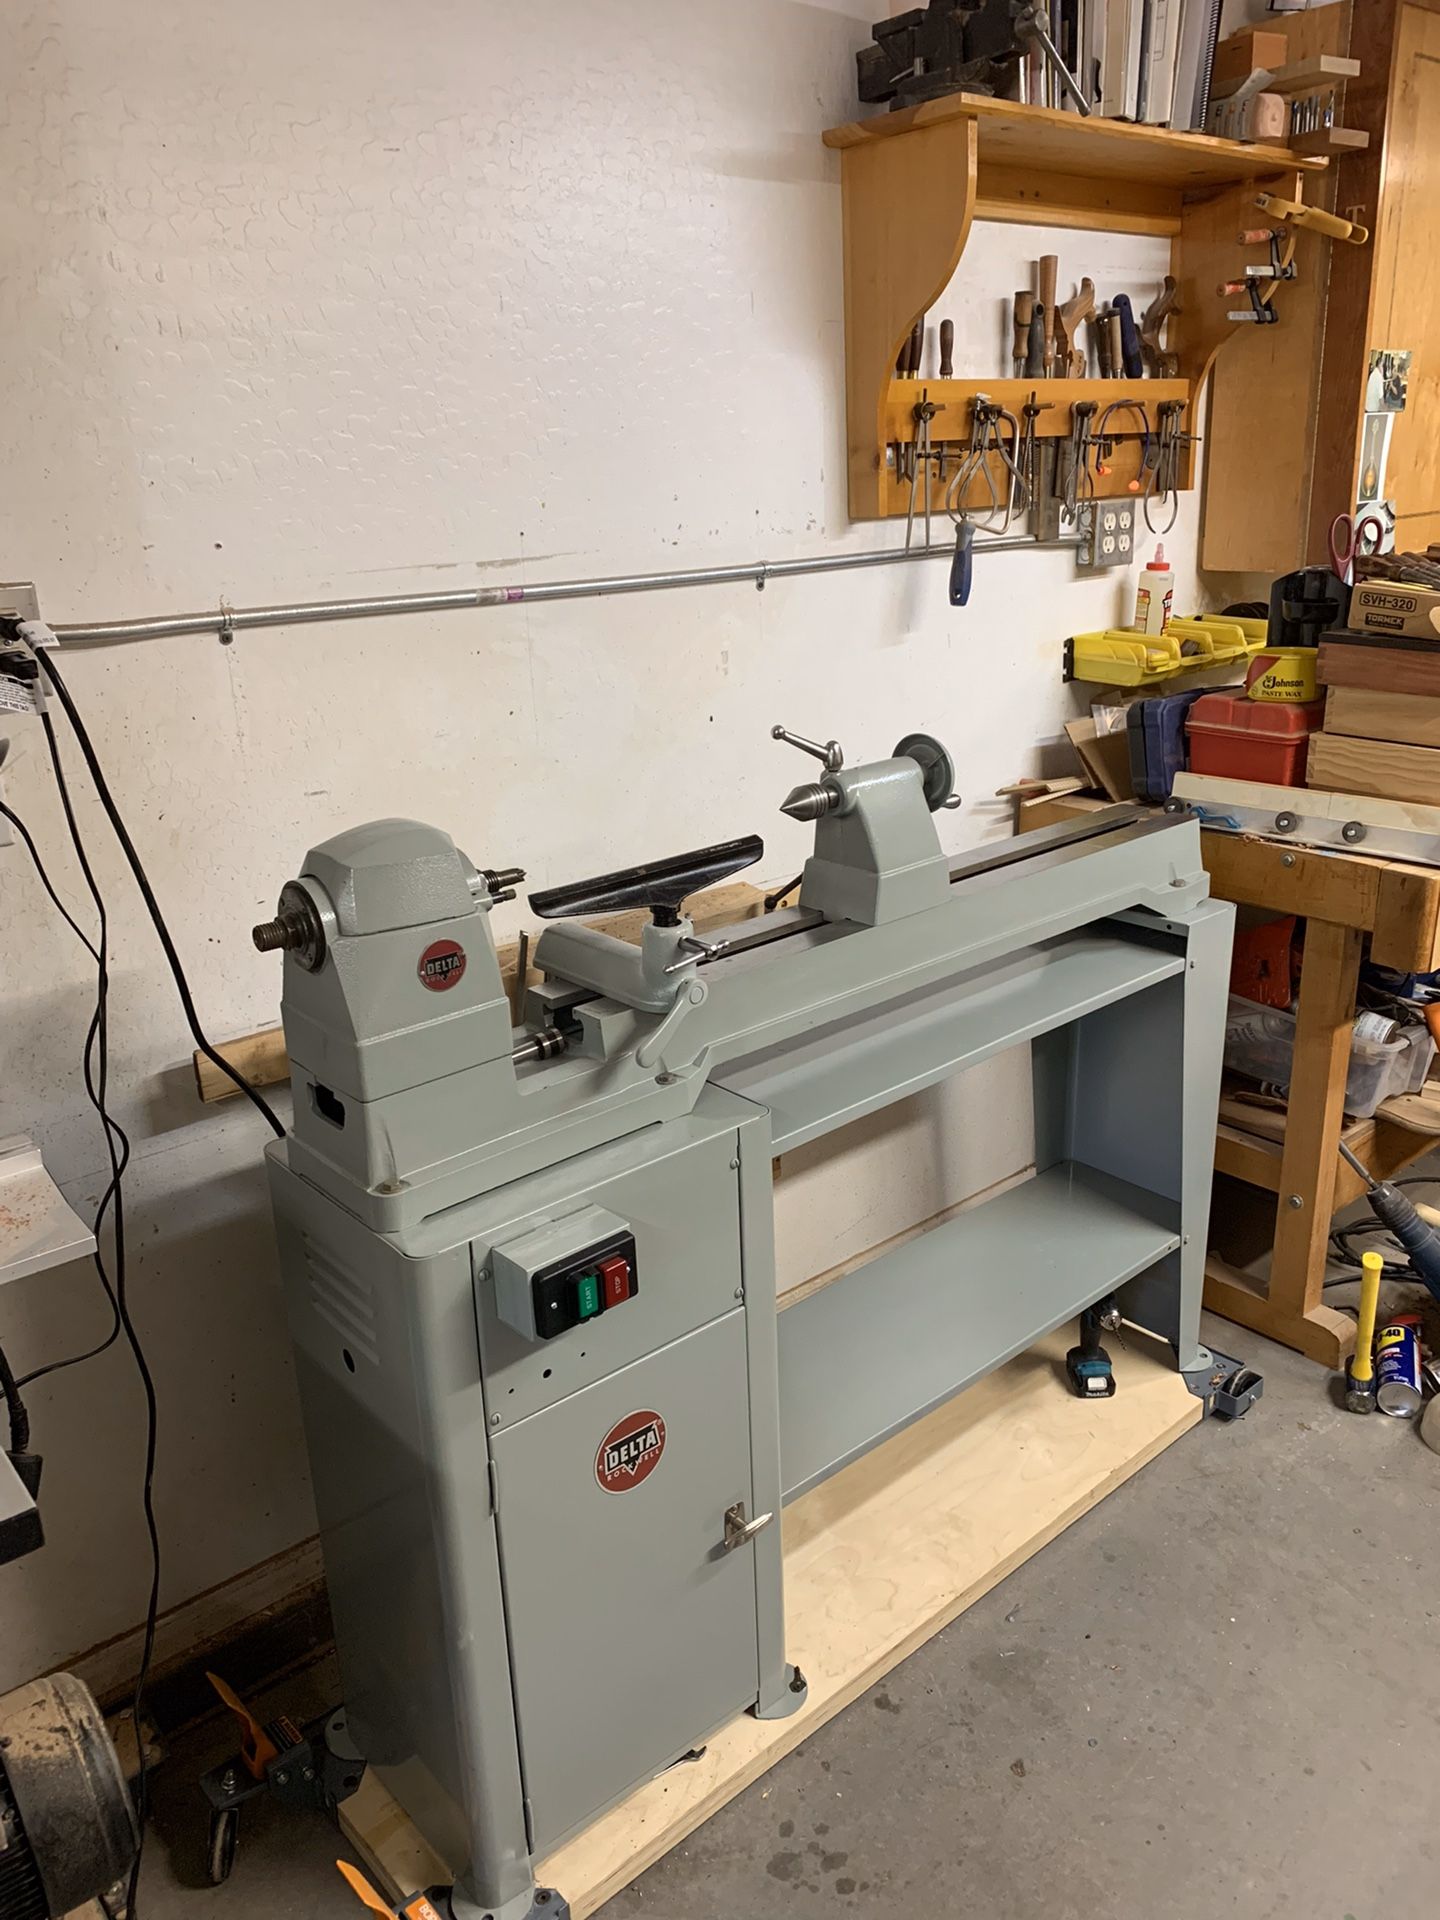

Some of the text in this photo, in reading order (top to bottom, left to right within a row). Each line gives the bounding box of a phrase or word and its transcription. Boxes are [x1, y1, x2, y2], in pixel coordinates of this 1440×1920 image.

[1362, 593, 1414, 611] SVH-320
[1366, 613, 1404, 626] TORMEK
[1270, 675, 1305, 690] Johnson
[1261, 689, 1303, 698] PASTE WAX
[426, 955, 461, 975] DELTA
[614, 1275, 622, 1295] STOP
[584, 1285, 593, 1310] START
[608, 1430, 657, 1470] DELTA
[606, 1448, 660, 1482] ROCKWELL
